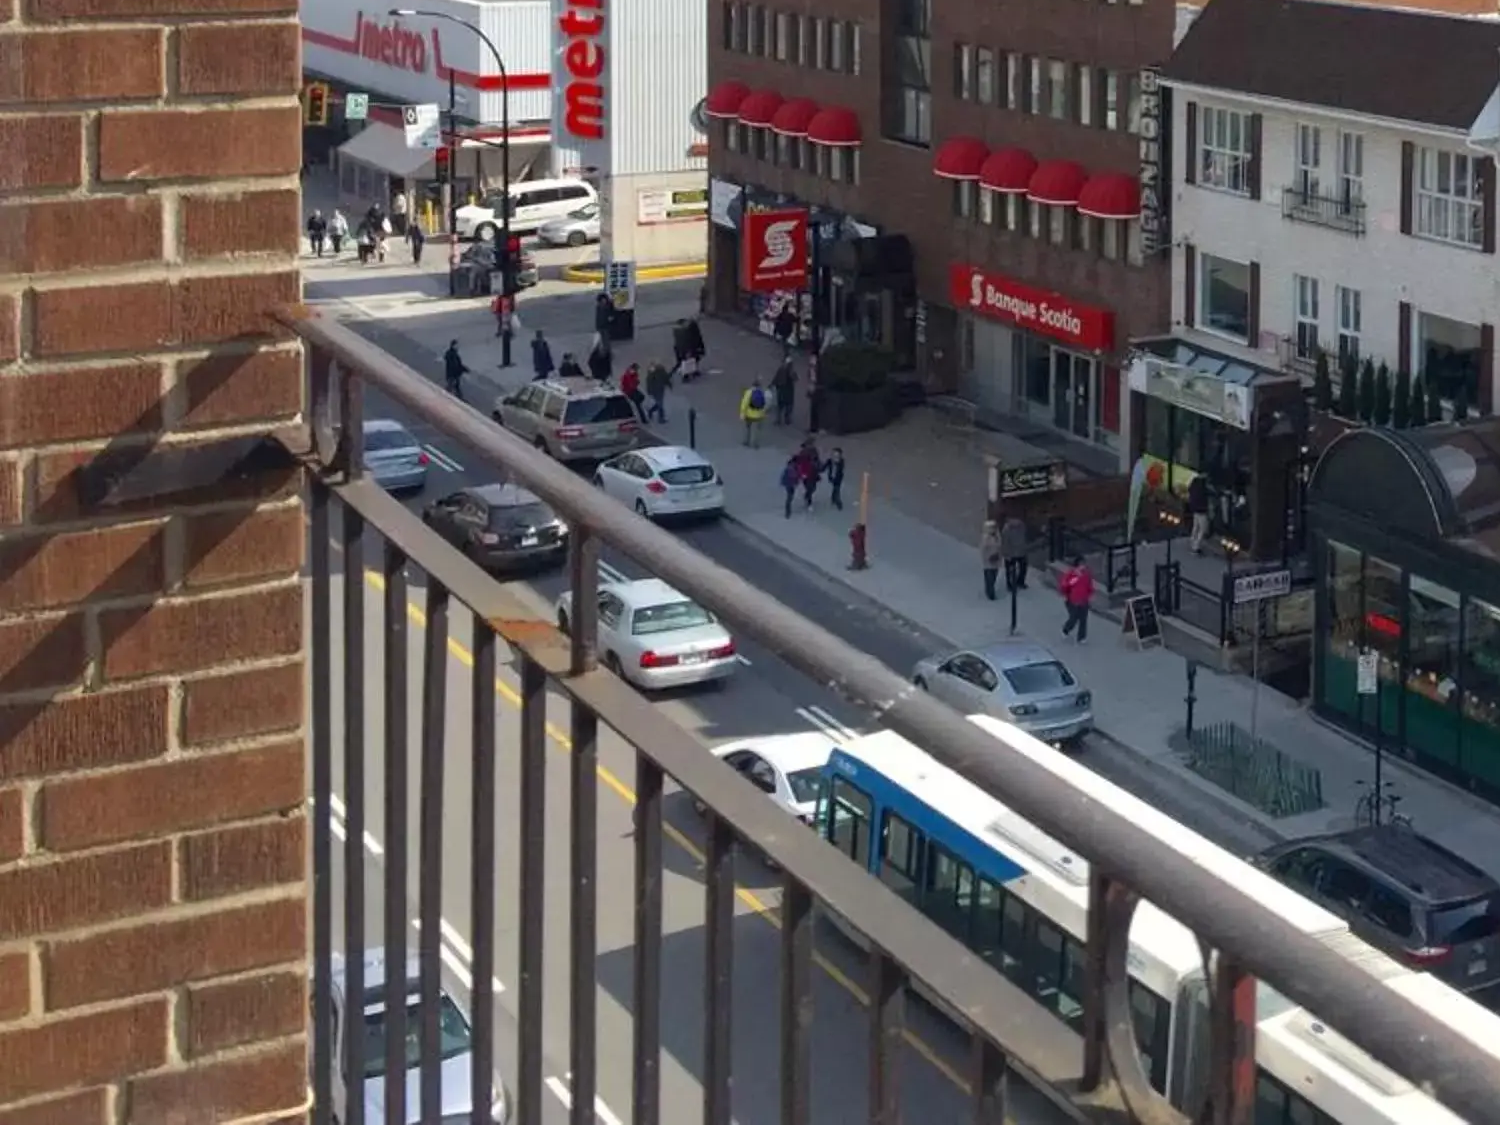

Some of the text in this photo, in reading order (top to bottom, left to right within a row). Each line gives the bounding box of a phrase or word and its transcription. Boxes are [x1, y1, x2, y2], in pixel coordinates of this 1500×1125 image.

[361, 19, 426, 74] metro
[985, 284, 1037, 322] Banque
[1039, 302, 1082, 336] Scotia
